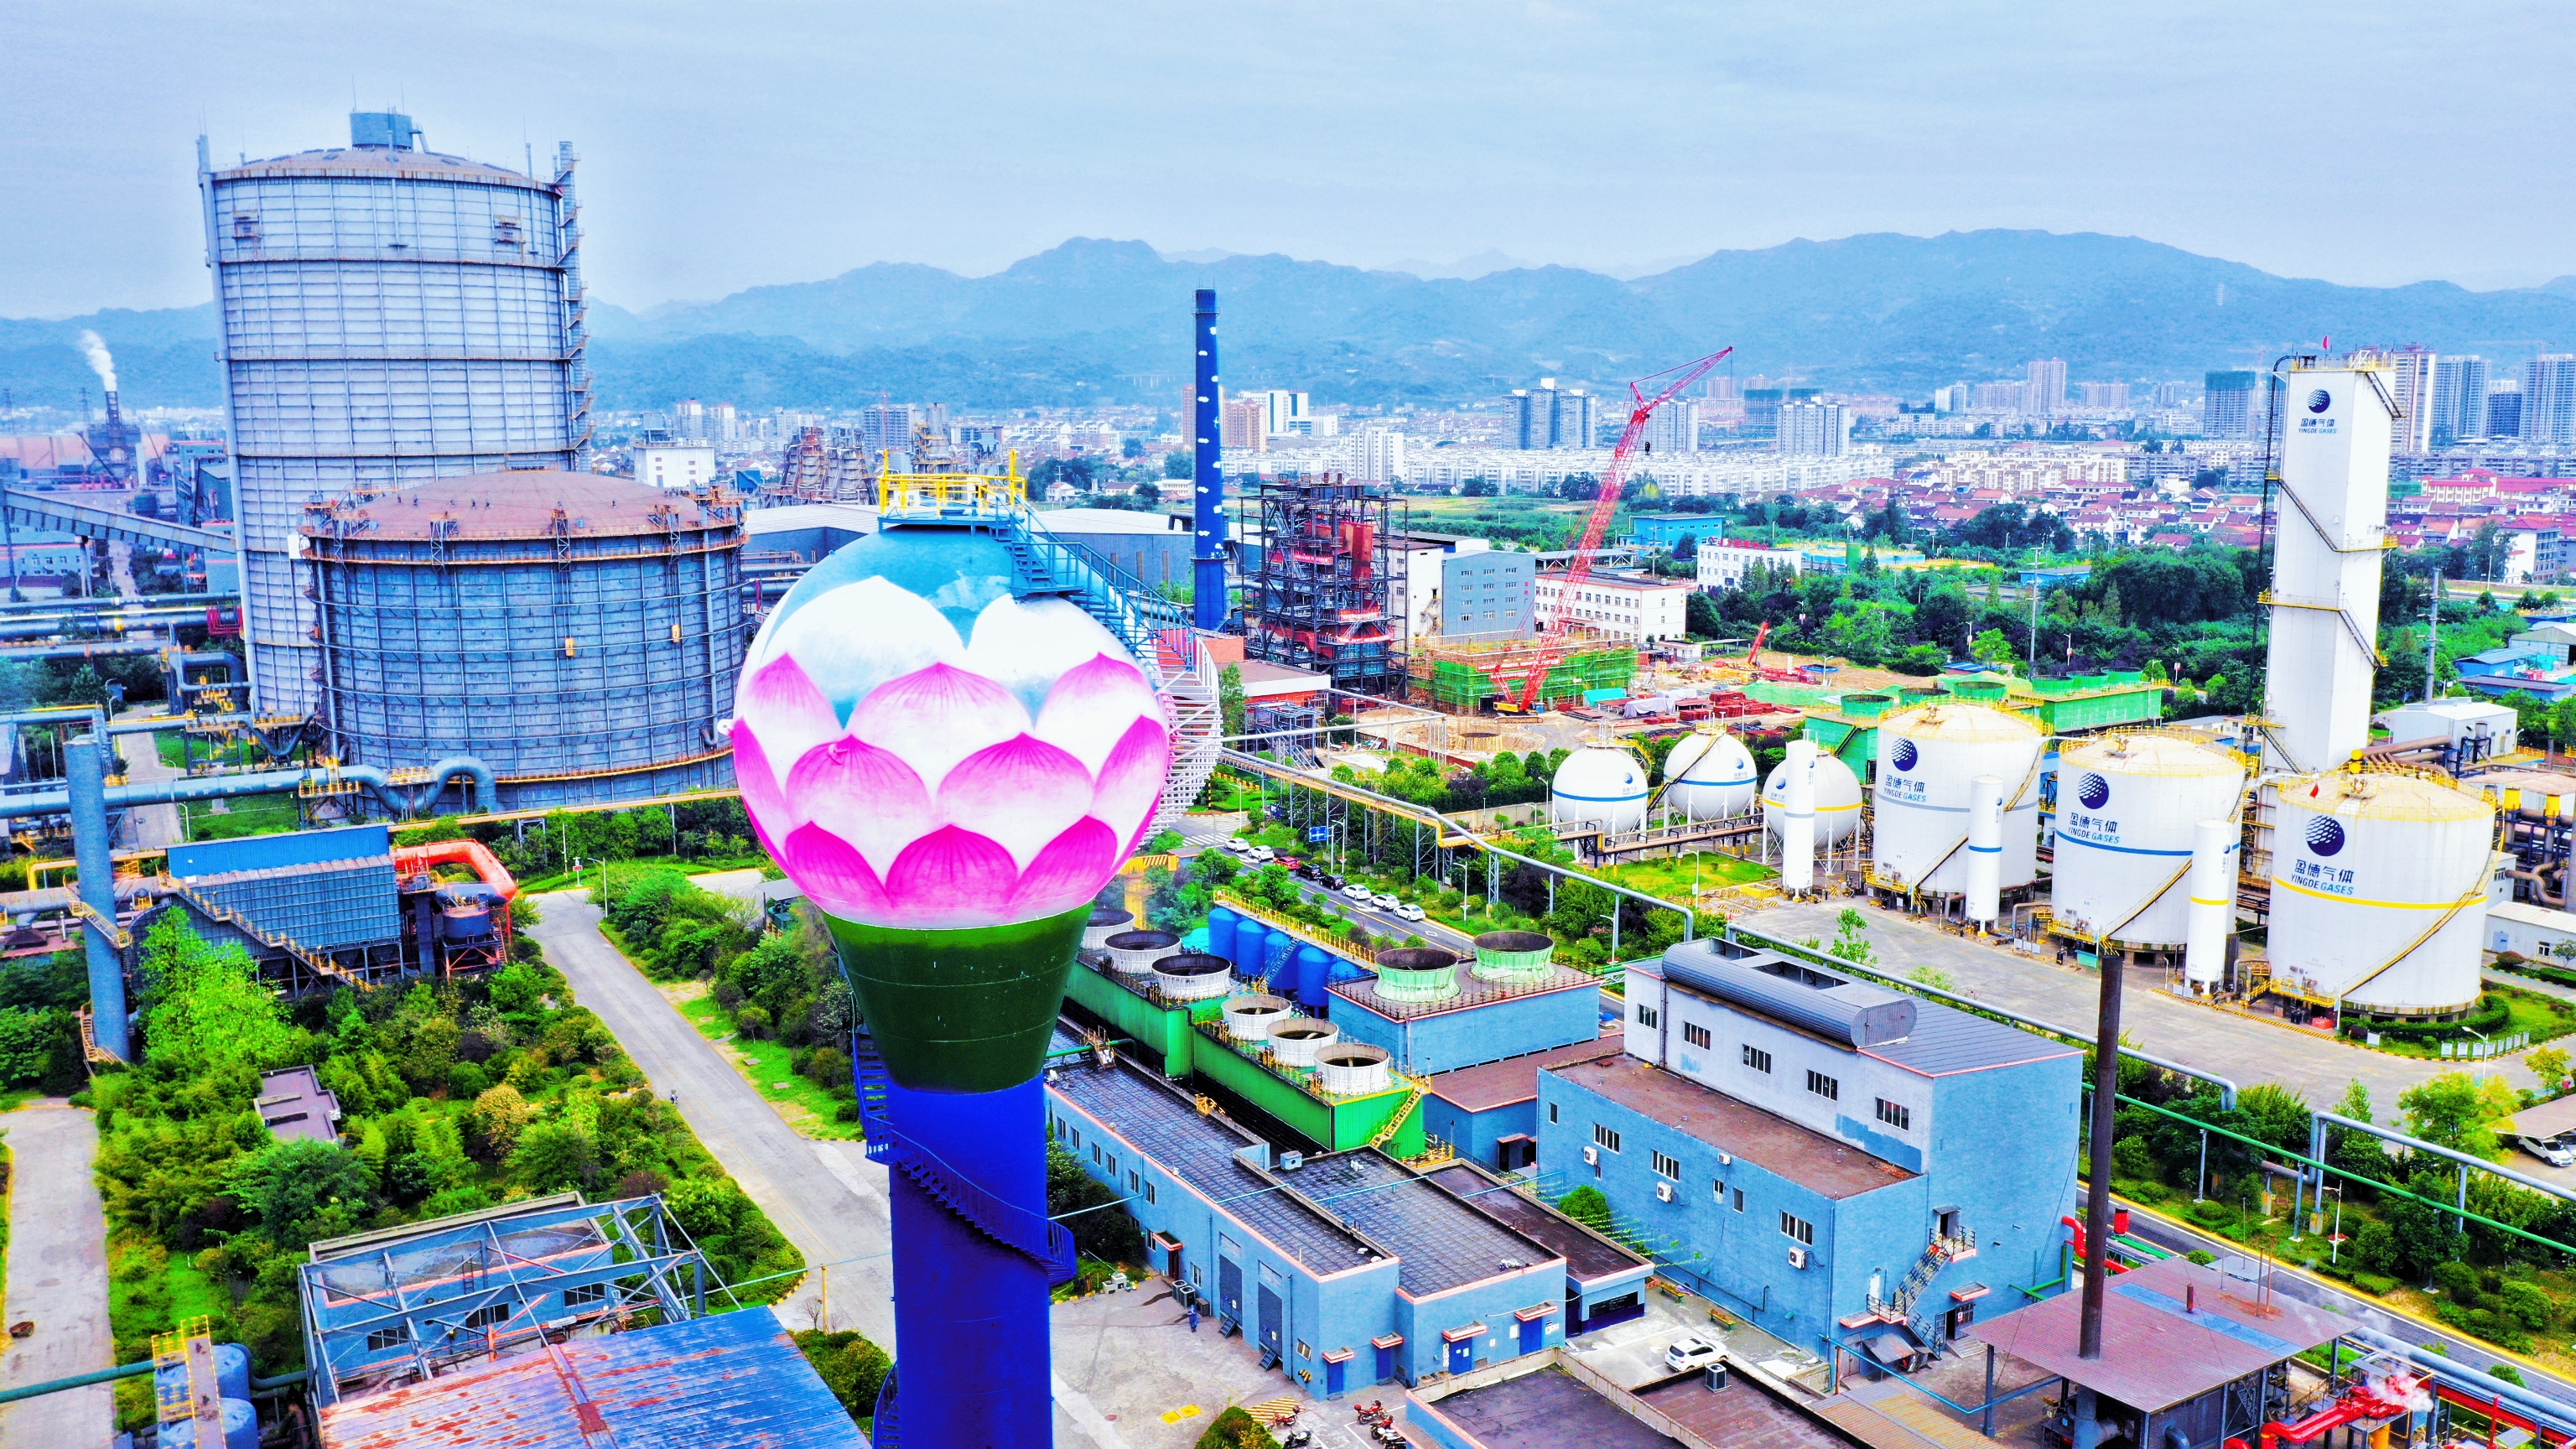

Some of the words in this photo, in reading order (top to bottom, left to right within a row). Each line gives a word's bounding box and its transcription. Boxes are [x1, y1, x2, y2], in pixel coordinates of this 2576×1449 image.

[1885, 775, 1925, 793] 盈德气体
[1883, 787, 1903, 798] YINGDE
[1903, 792, 1927, 802] GASES
[2070, 813, 2118, 834] 盈德气体
[2068, 826, 2090, 839] YINGDE
[2091, 833, 2120, 844] GASES
[2295, 859, 2355, 883] 盈德气体
[2291, 873, 2319, 889] YINGDE
[2320, 882, 2354, 896] GASES
